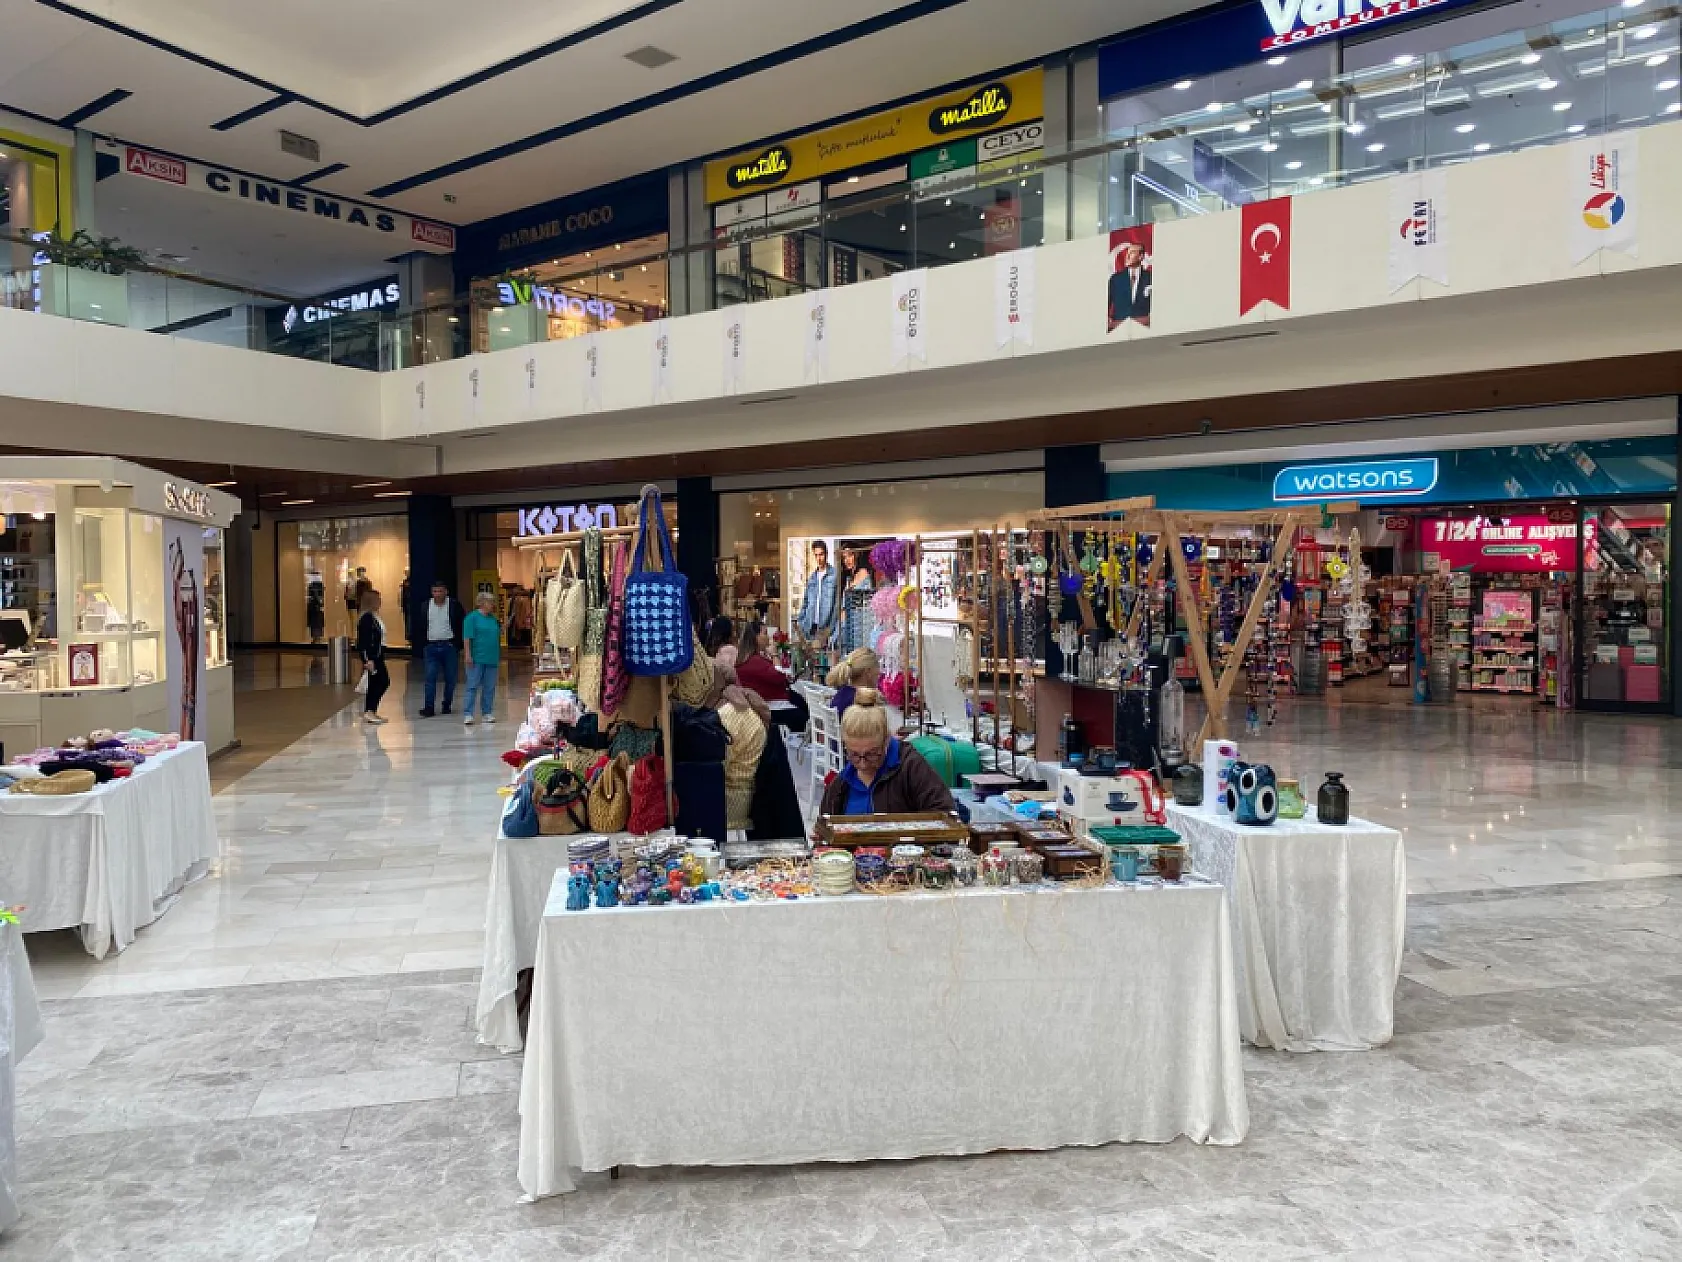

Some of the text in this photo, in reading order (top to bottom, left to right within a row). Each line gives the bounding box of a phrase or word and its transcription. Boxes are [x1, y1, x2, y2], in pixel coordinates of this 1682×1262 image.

[983, 126, 1042, 150] CEYO
[205, 171, 396, 233] CINEMAS
[565, 205, 613, 233] COCO
[303, 281, 400, 323] CINEMAS
[1293, 468, 1414, 492] watsons
[518, 503, 616, 537] KOTON
[1480, 526, 1524, 540] ONLINE
